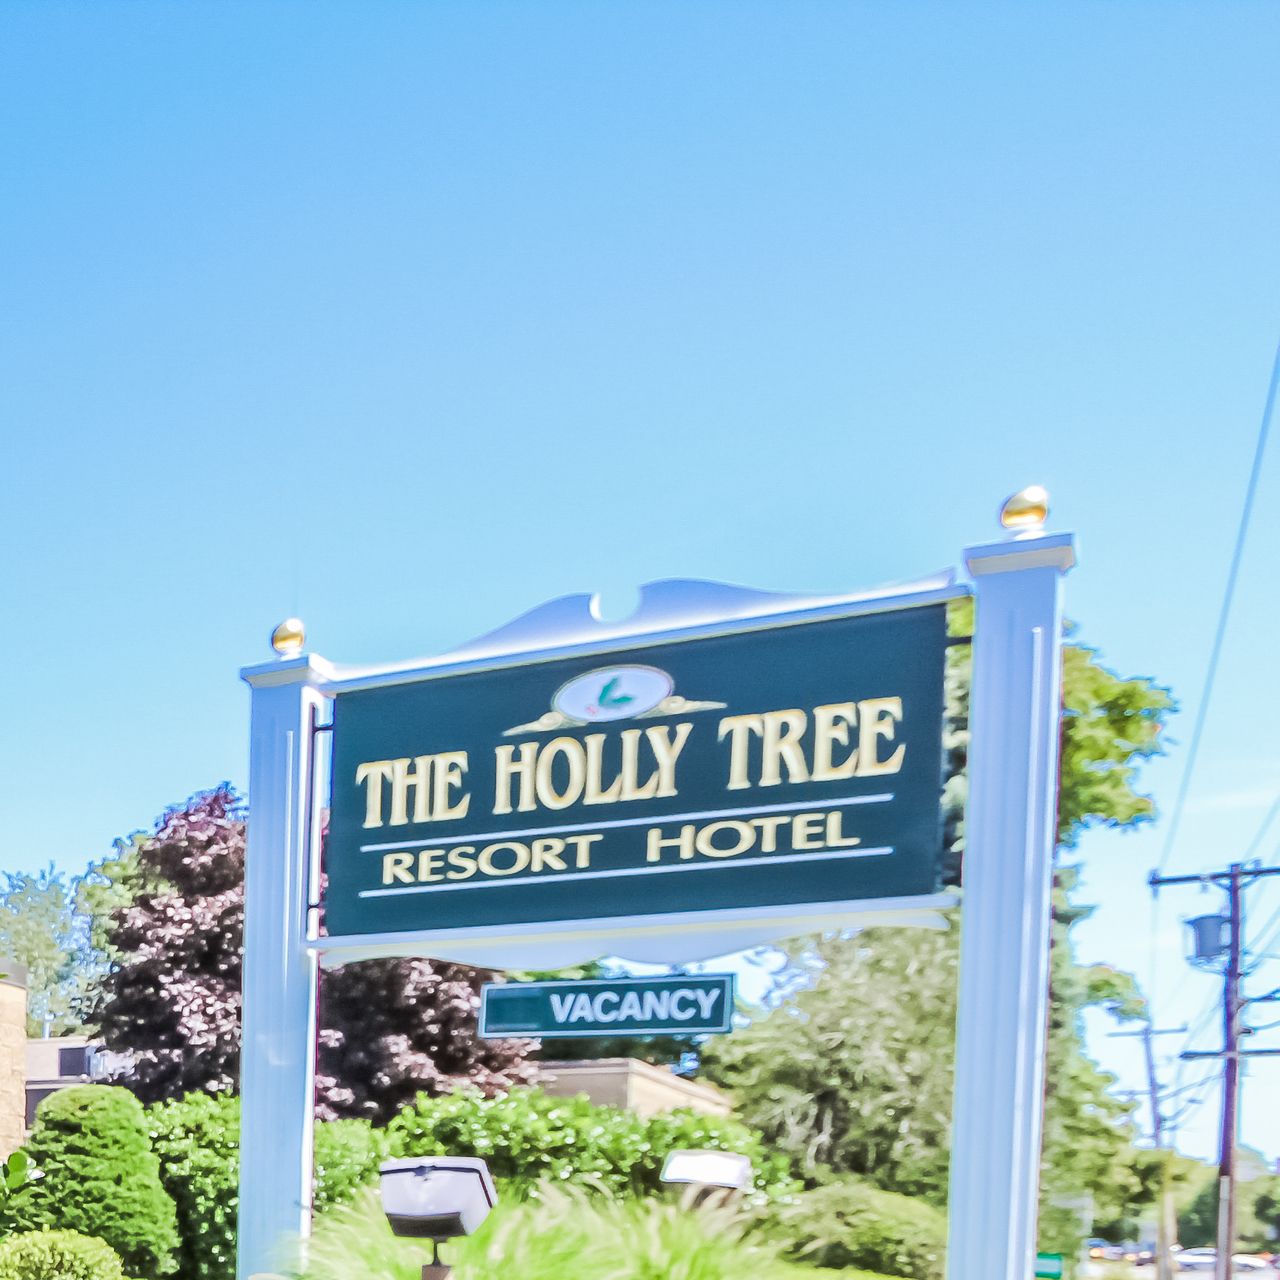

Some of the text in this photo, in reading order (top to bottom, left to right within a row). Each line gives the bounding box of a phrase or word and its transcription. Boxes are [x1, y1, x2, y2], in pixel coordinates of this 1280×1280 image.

[356, 698, 905, 828] THE HOLLY TREE
[383, 812, 860, 884] RESORT HOTEL
[550, 988, 720, 1023] VACANCY
